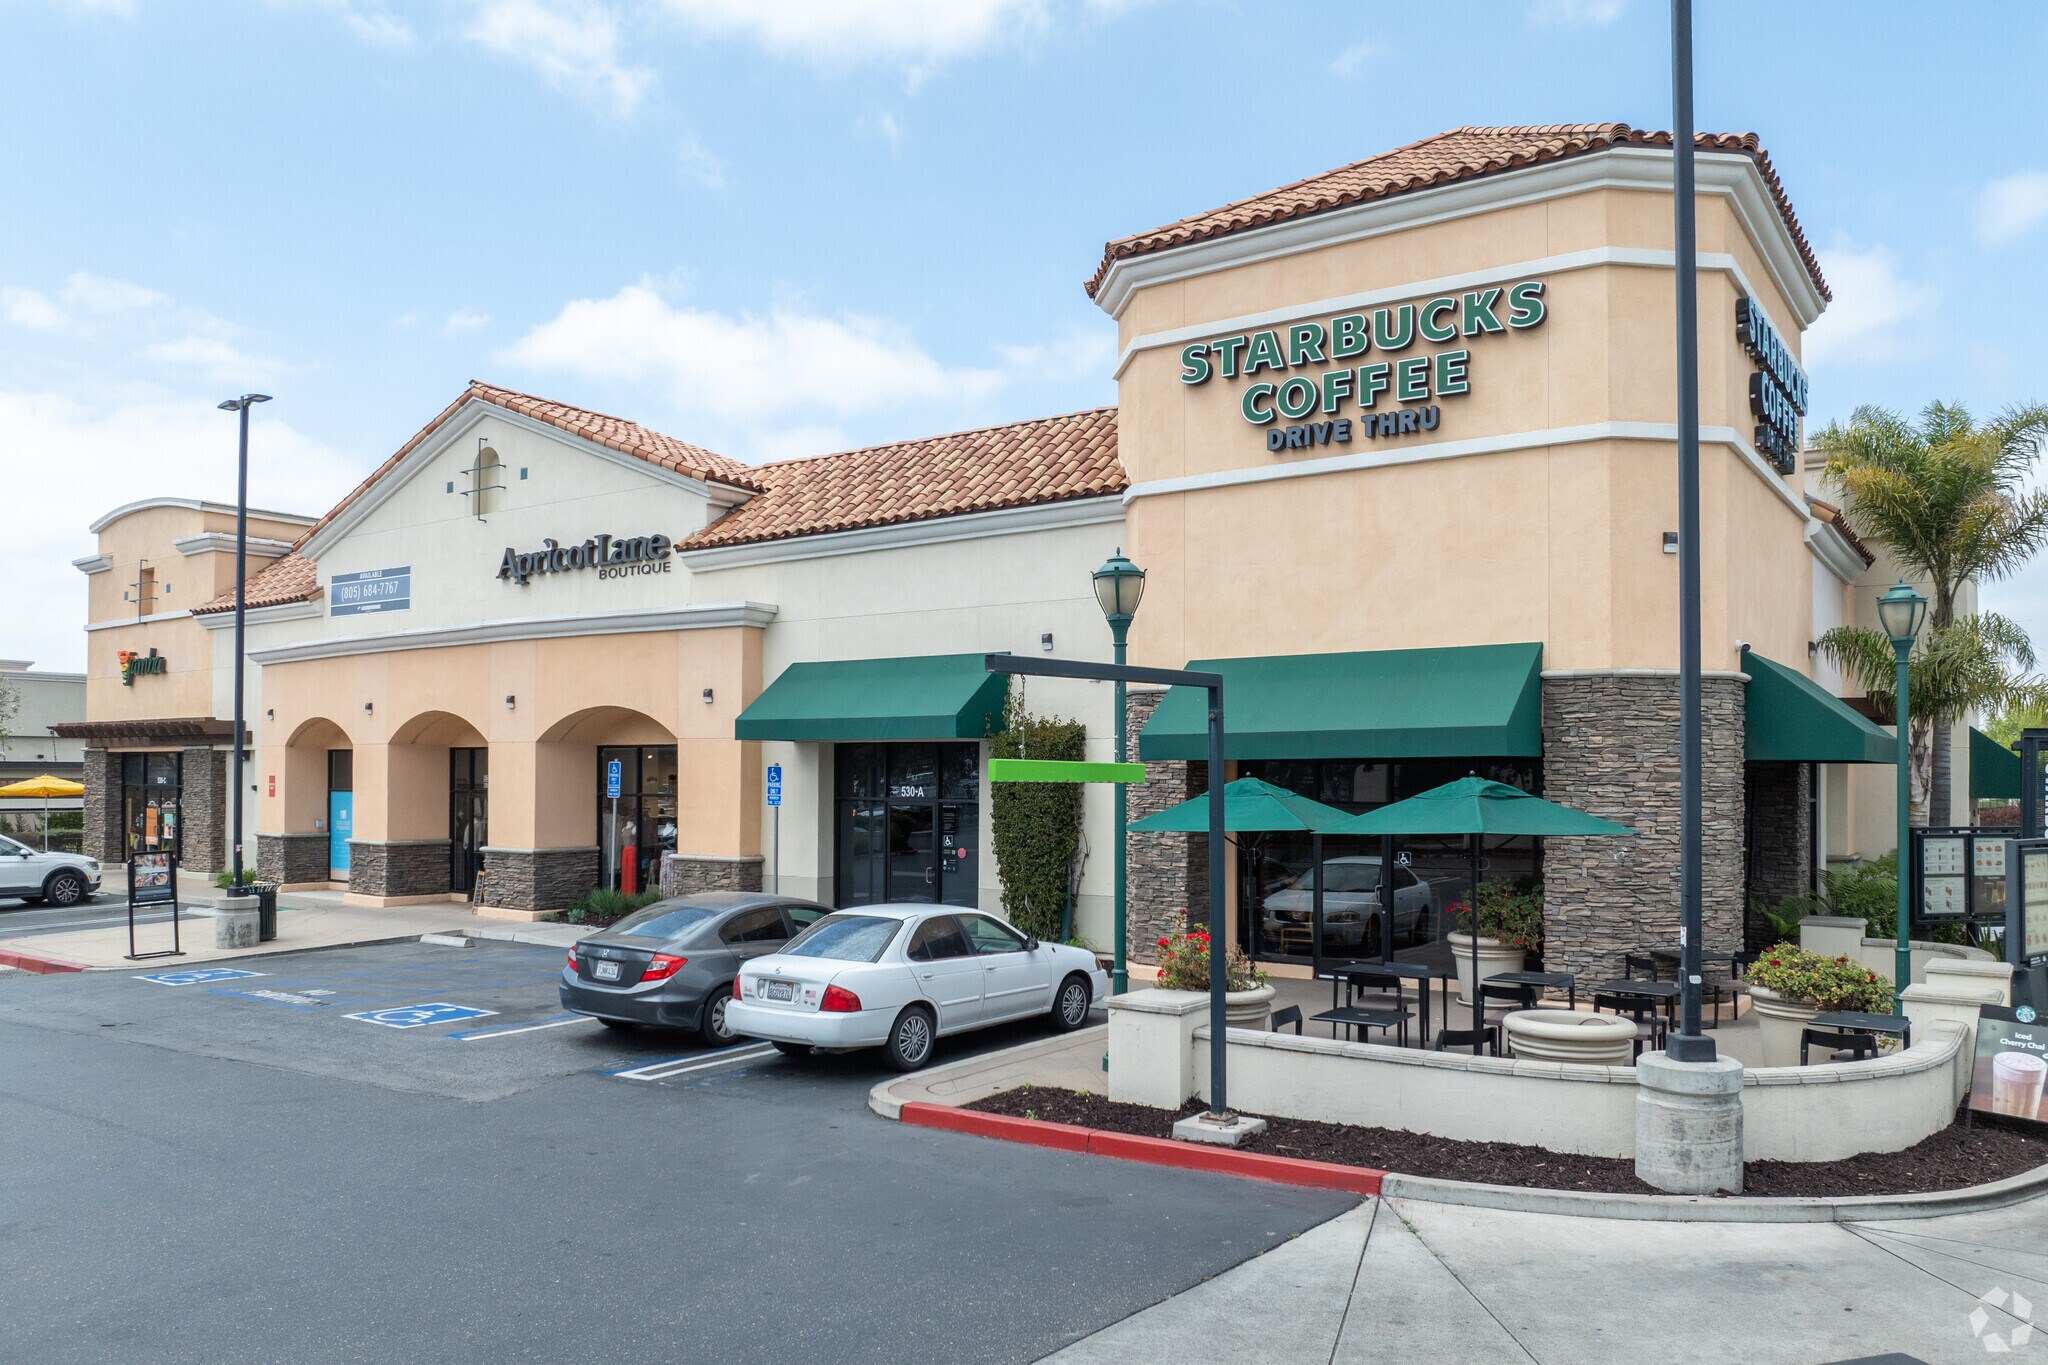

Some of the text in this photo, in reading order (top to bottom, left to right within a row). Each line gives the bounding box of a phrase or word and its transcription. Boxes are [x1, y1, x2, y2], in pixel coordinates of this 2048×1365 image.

[1180, 281, 1548, 386] STARBUCKS
[1745, 297, 1809, 417] STARBUCKS
[1240, 349, 1471, 425] COFFEE
[1267, 405, 1440, 452] DRIVE THRU
[1757, 370, 1799, 453] COFFEE
[359, 570, 383, 580] AVAILABLE
[599, 561, 671, 580] BOUTIQUE
[341, 581, 399, 602] (805) 684-7767
[2000, 1038, 2046, 1051] Cherry Chai
[2014, 1032, 2032, 1041] Iced
